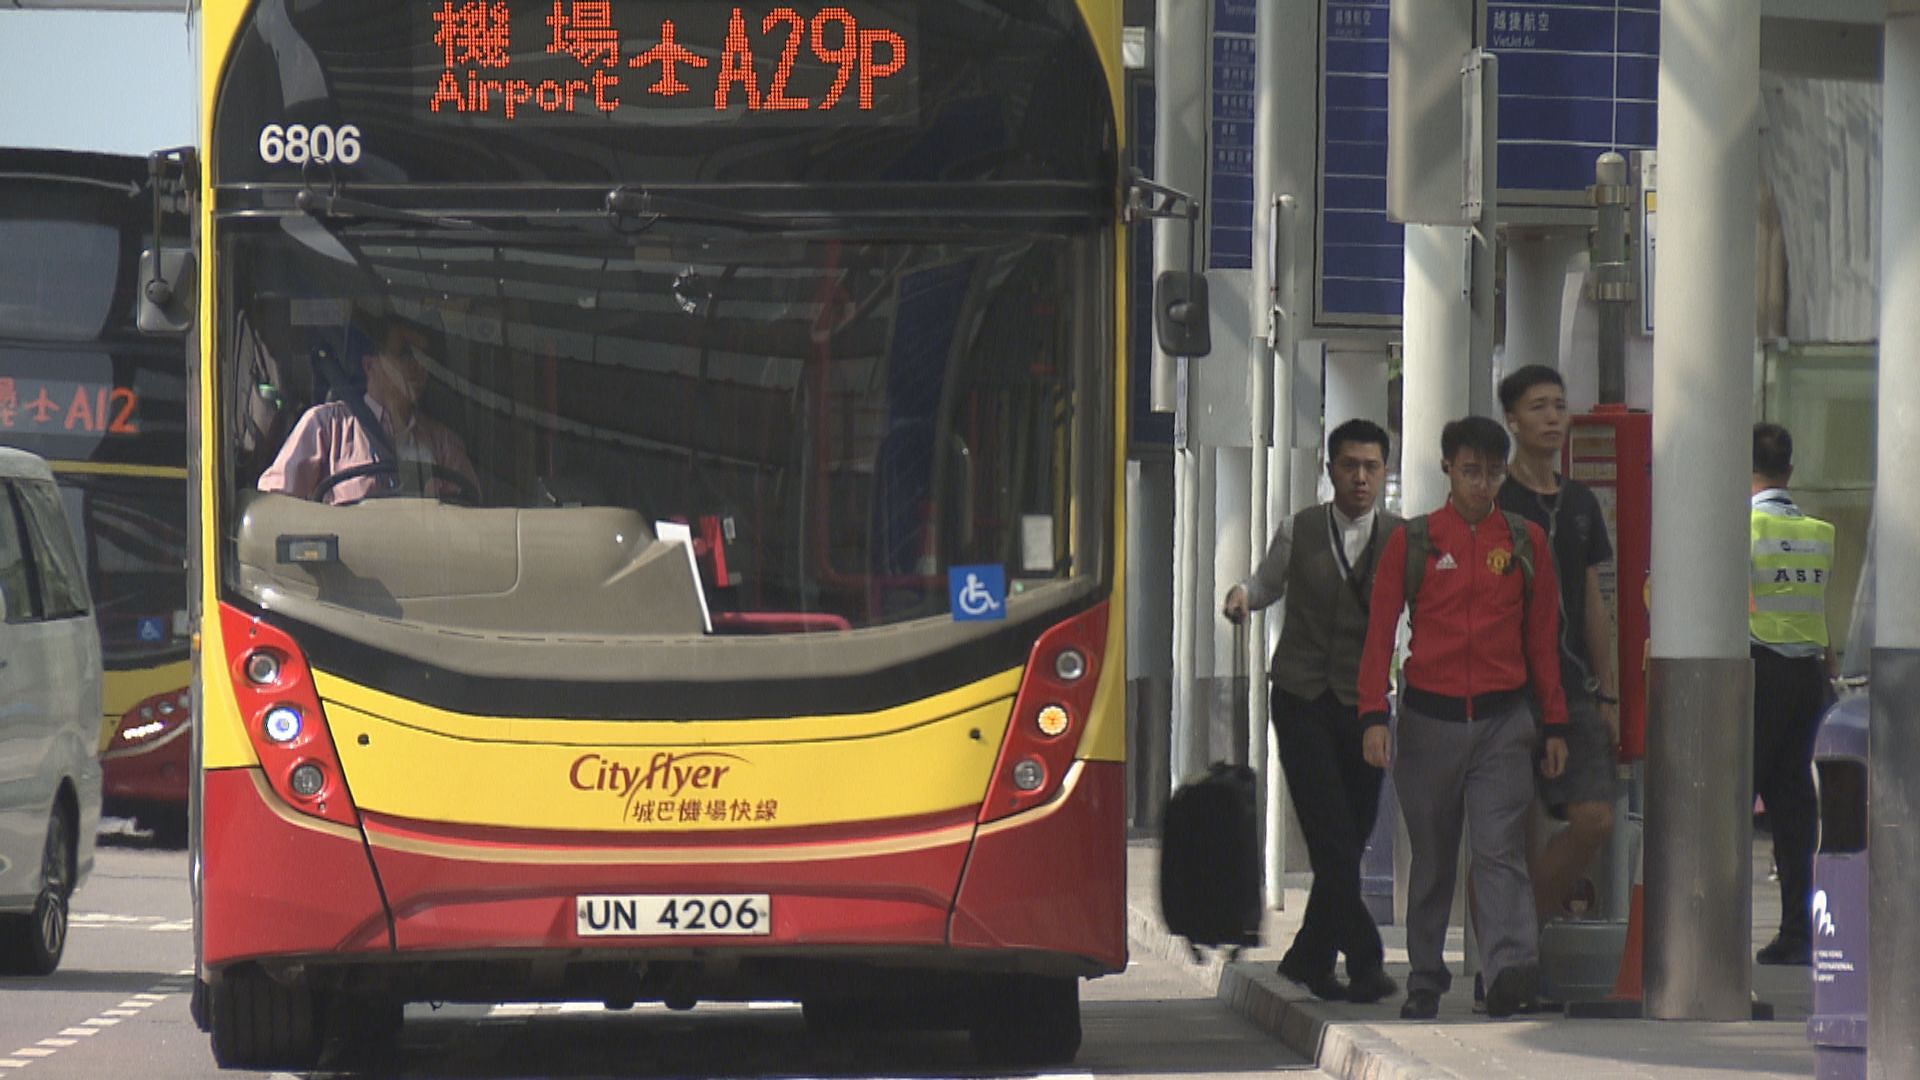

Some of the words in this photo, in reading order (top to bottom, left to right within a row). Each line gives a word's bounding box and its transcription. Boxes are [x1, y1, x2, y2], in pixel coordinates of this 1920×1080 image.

[432, 1, 619, 68] 機場
[1493, 11, 1549, 31] 越捷航空
[714, 8, 906, 110] A29P
[430, 70, 620, 119] Airport
[260, 124, 361, 164] 6806
[64, 384, 138, 433] A12
[632, 798, 779, 823] 城巴機場快線
[586, 899, 637, 930] UN
[657, 898, 759, 930] 4206
